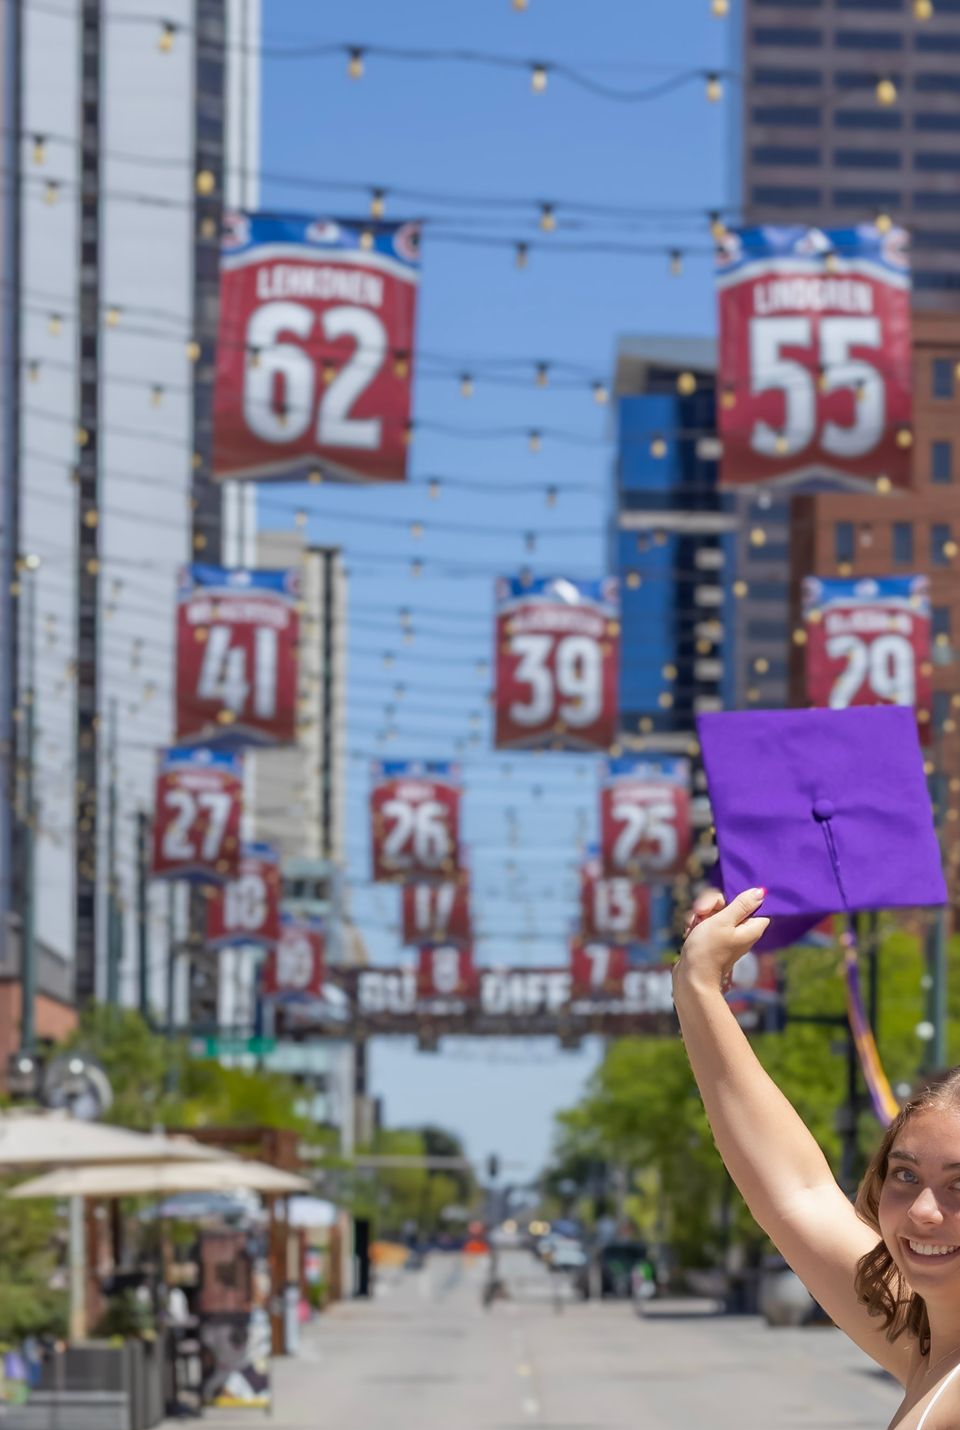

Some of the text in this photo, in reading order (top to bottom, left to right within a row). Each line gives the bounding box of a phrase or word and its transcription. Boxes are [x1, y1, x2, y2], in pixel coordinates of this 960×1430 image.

[243, 300, 388, 449] 62
[749, 316, 886, 458] 55
[198, 624, 278, 719] 41
[510, 633, 603, 727] 39
[826, 634, 915, 710] 29
[162, 790, 231, 860] 27
[381, 800, 451, 869] 26
[610, 801, 679, 871] 25
